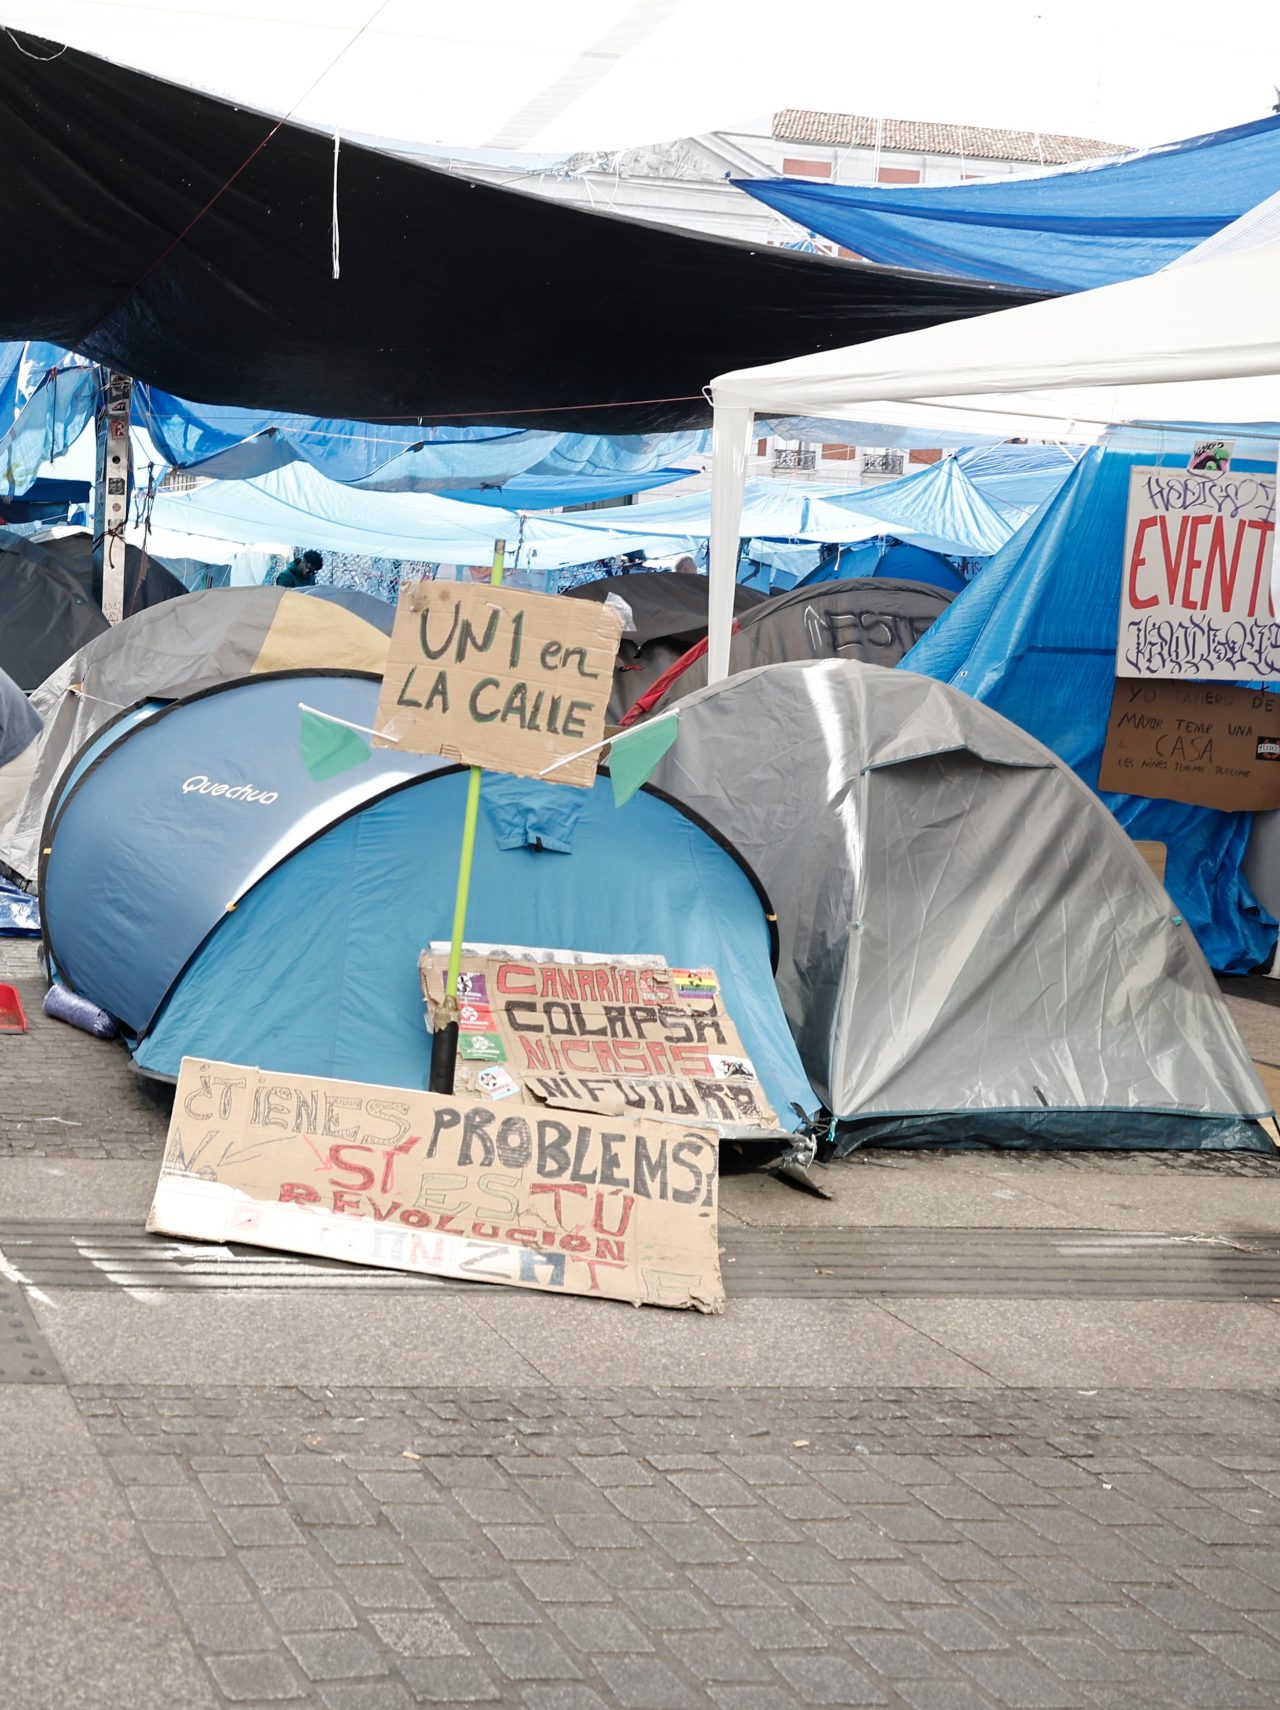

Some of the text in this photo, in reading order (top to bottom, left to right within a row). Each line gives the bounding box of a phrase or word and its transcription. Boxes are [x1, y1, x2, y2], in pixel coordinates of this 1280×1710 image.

[1129, 515, 1276, 618] EVENT
[397, 665, 596, 738] LA CALLE
[1129, 684, 1157, 705] YO
[1117, 712, 1163, 730] MAYOR
[1228, 724, 1253, 737] UNA
[1155, 734, 1214, 764] CASA
[182, 775, 279, 805] Quechua
